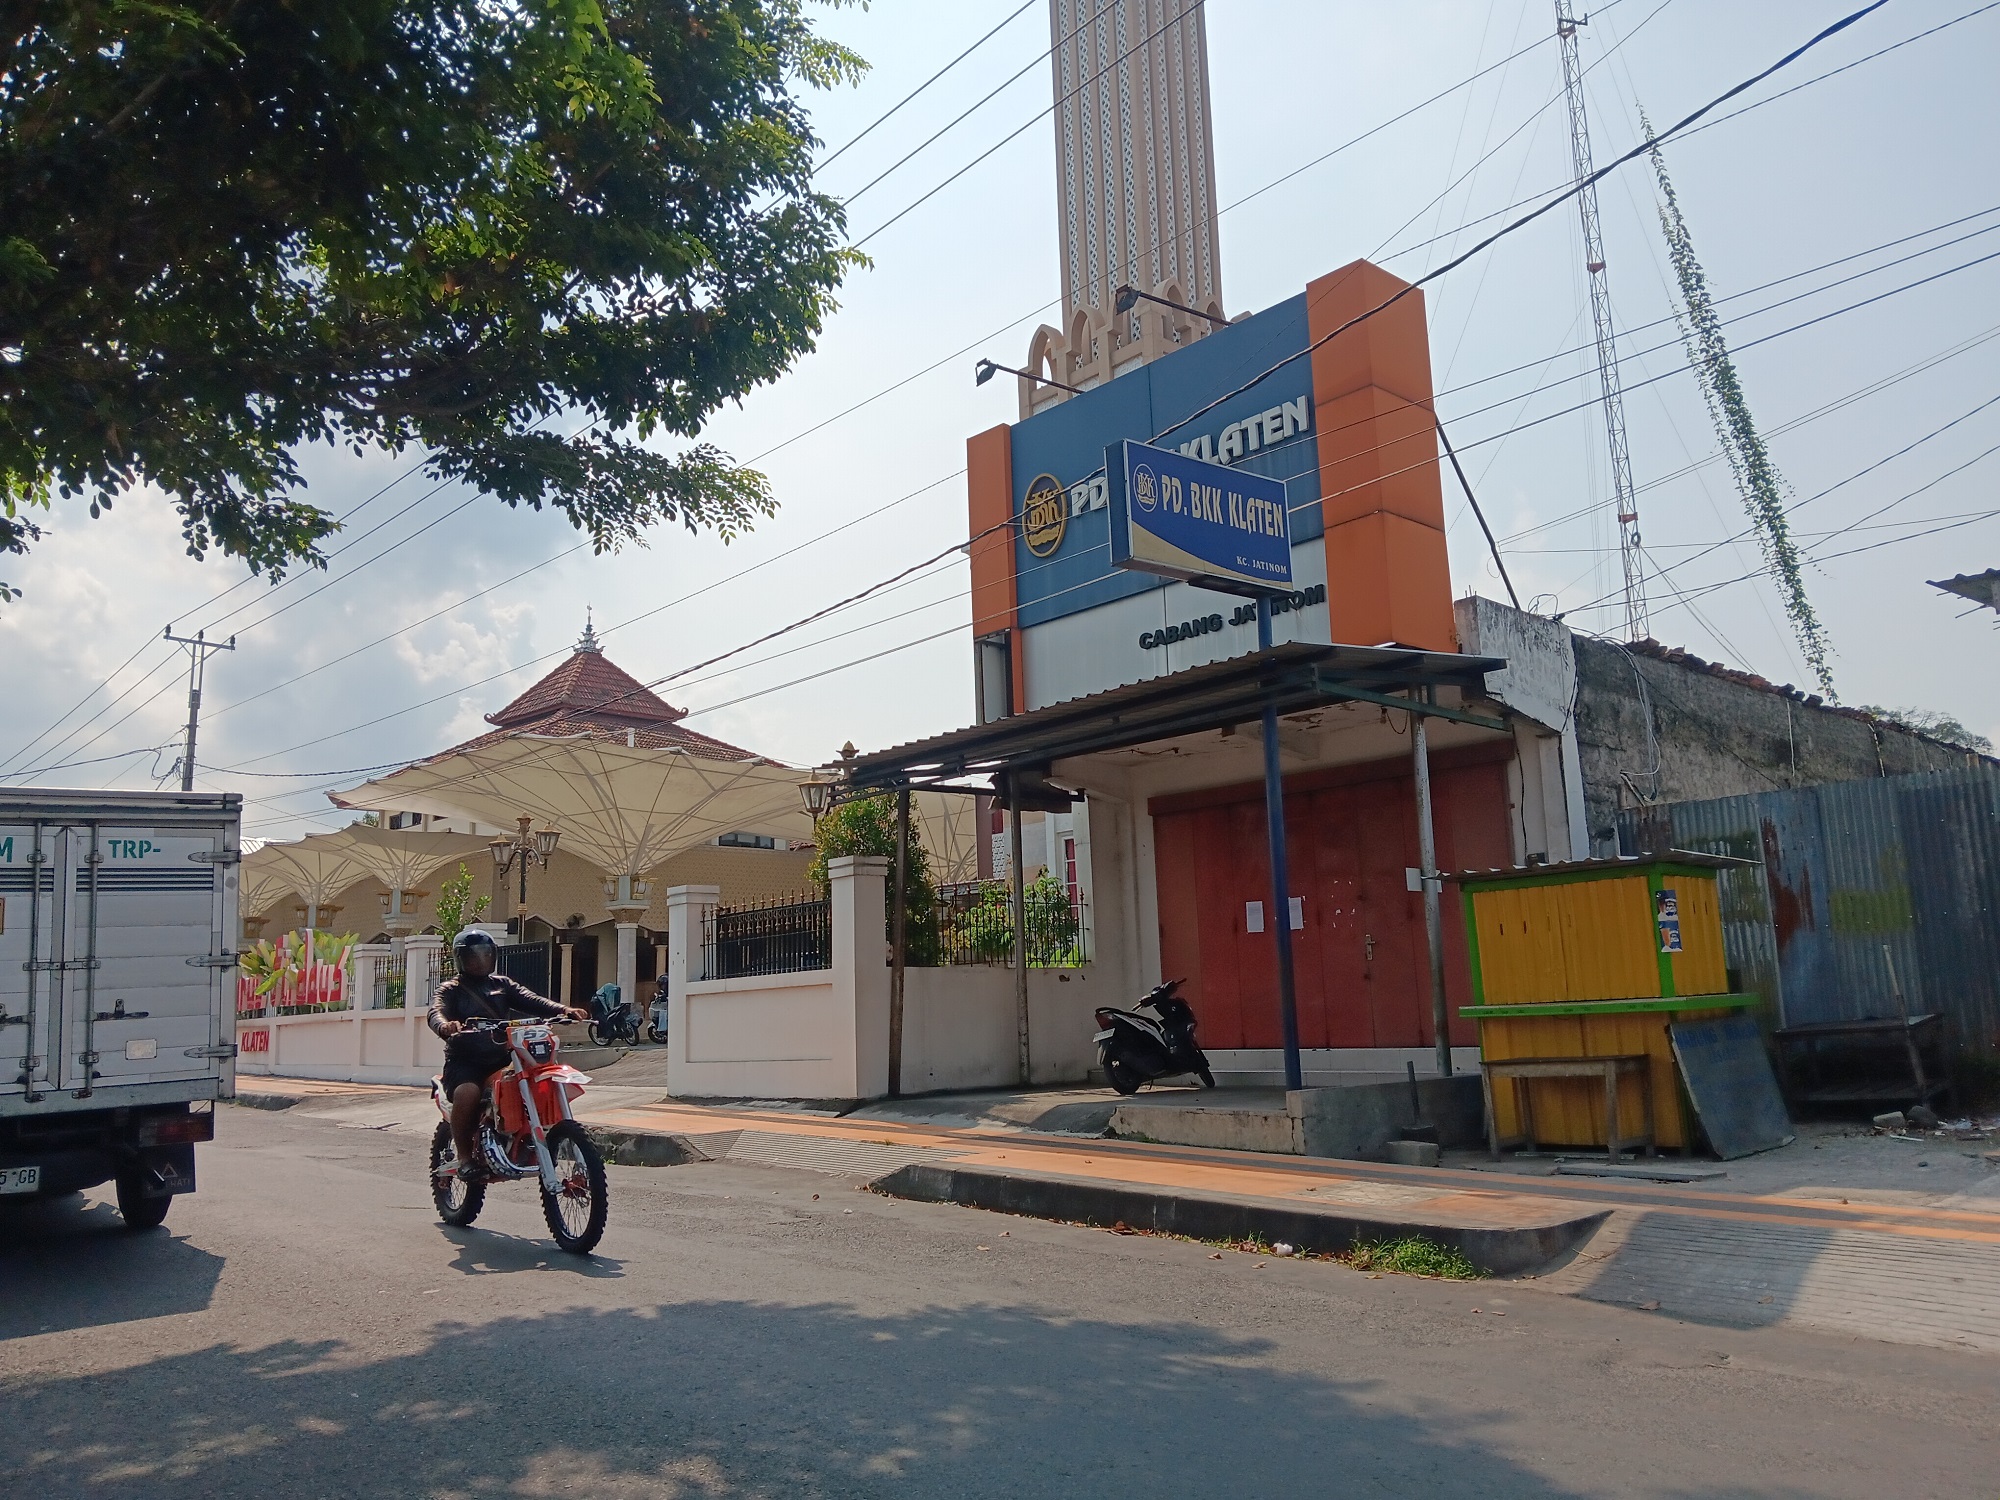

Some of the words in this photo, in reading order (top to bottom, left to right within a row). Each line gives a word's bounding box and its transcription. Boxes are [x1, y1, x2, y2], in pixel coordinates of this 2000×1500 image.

[1180, 395, 1309, 466] KLATEN
[1162, 474, 1188, 516] PD.
[1190, 481, 1224, 525] BKK
[1228, 491, 1285, 539] KLATEN
[1236, 556, 1250, 567] KC.
[1252, 559, 1288, 575] JATINOM
[1139, 613, 1222, 650] CABANG
[1228, 584, 1325, 627] JANOM
[108, 839, 161, 859] TRP-
[241, 1030, 270, 1052] KLATEN
[19, 1169, 37, 1184] GB
